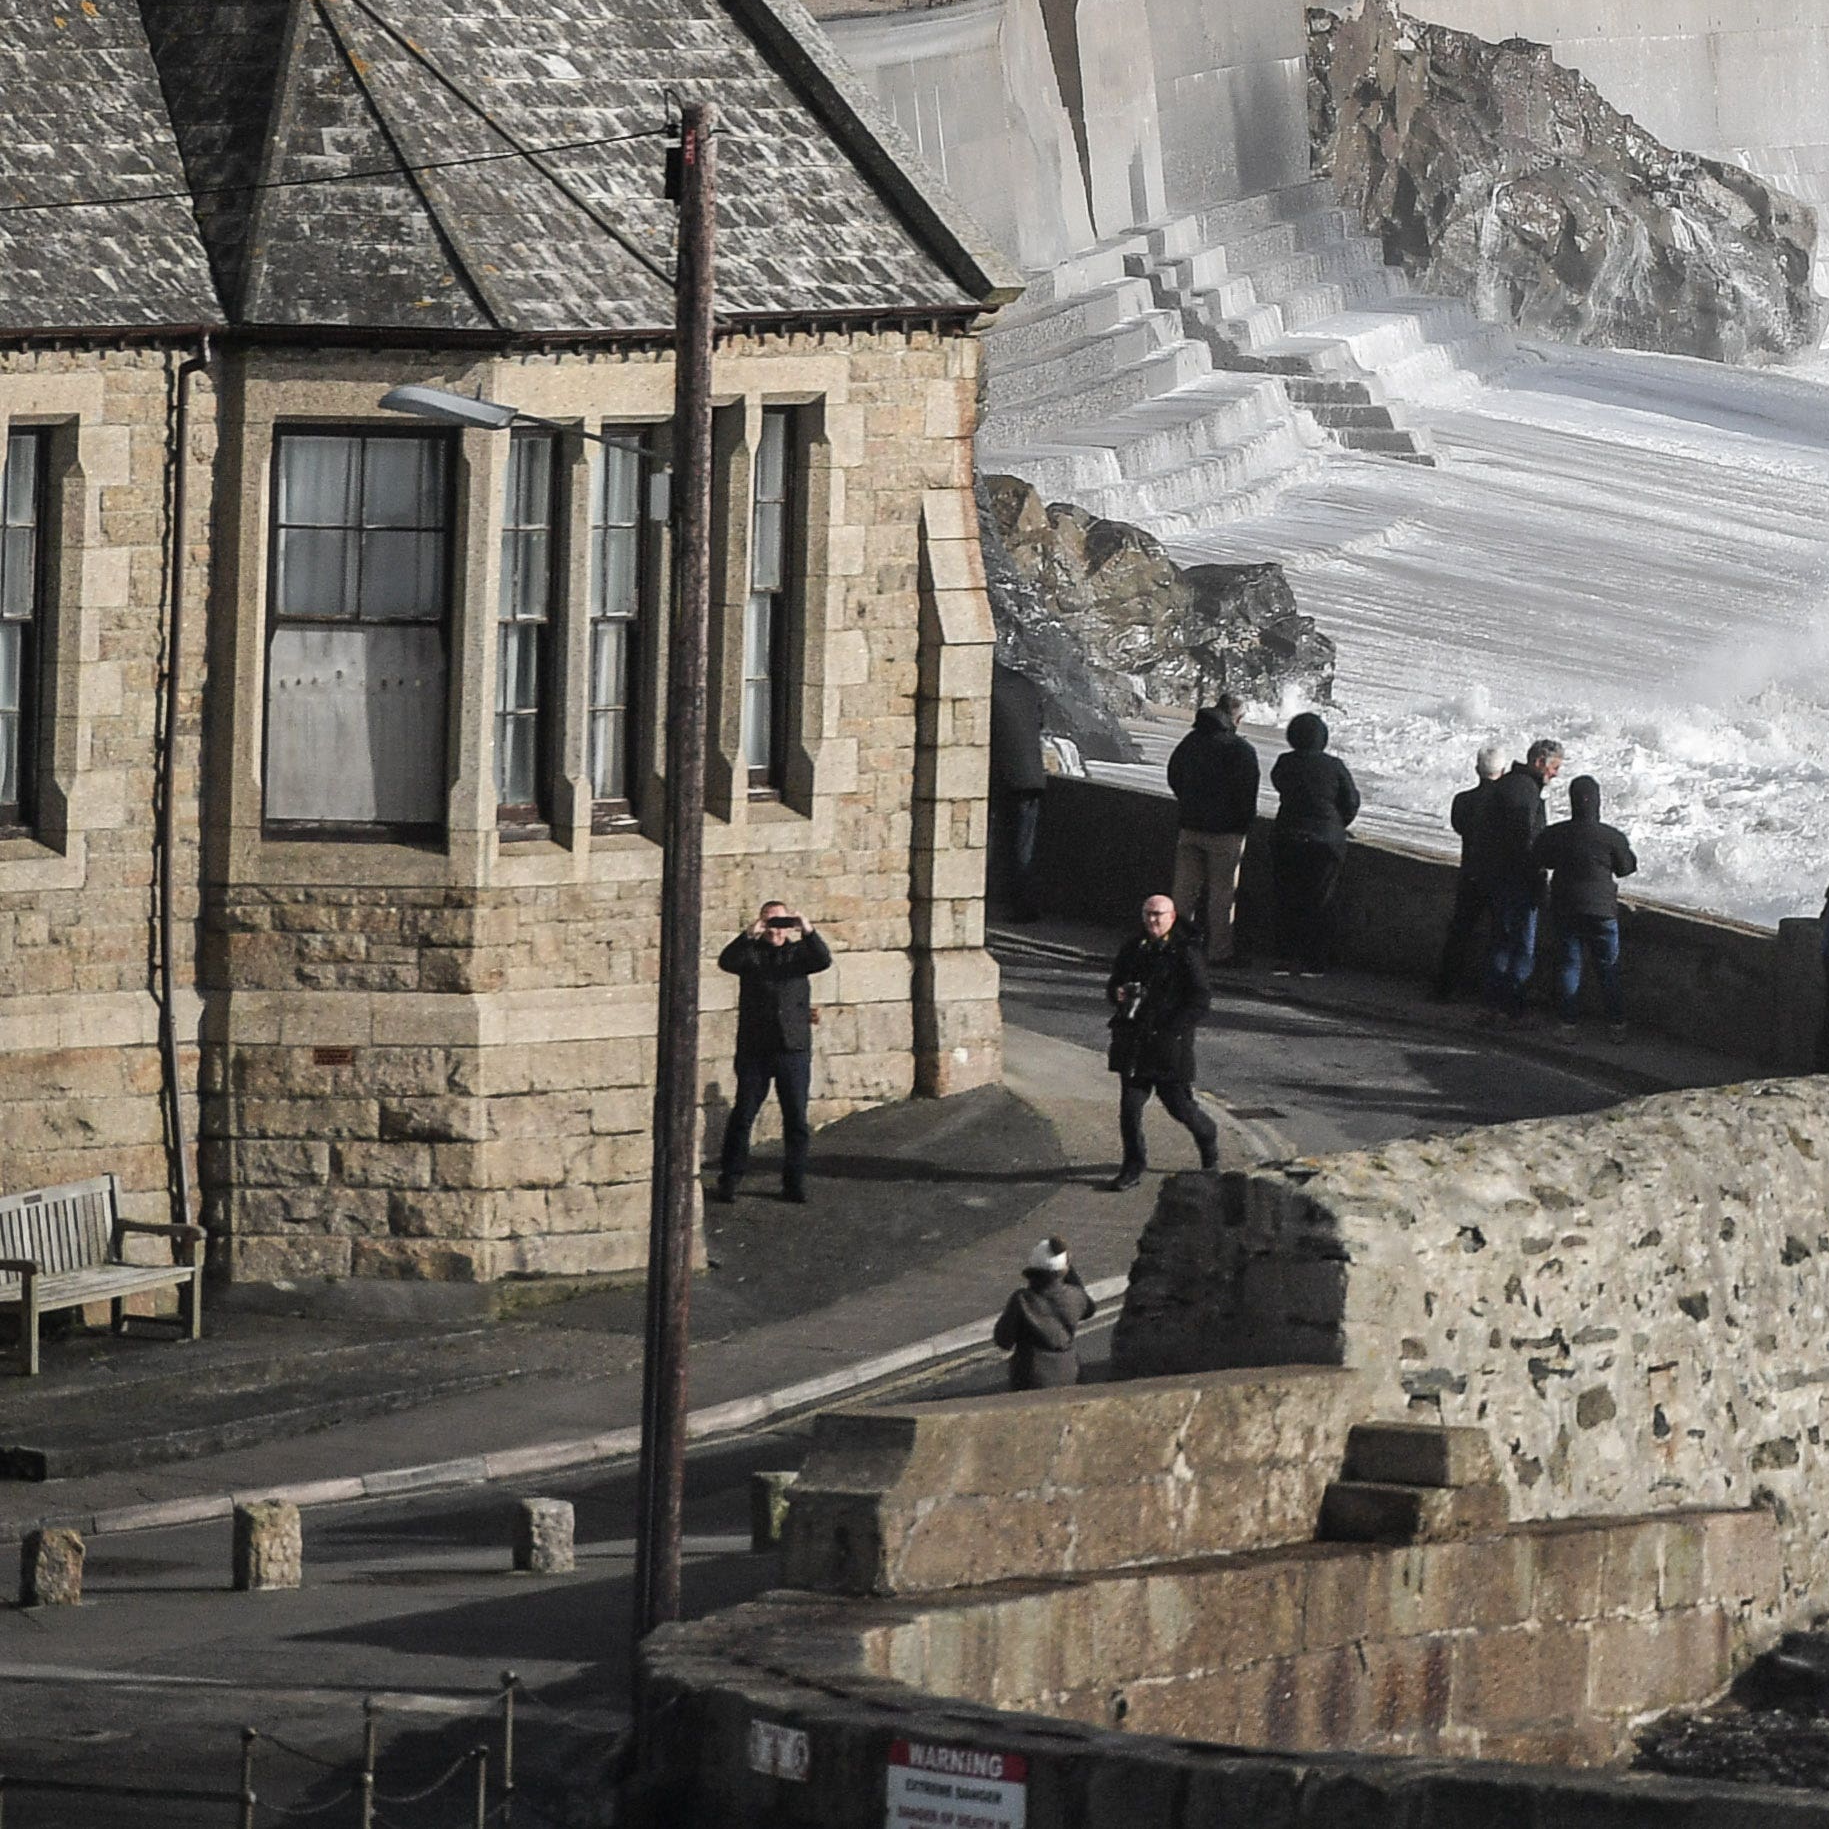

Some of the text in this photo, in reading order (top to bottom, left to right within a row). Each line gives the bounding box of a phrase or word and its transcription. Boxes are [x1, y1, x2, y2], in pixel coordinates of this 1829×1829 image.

[909, 1743, 1003, 1777] WARNING
[905, 1778, 1003, 1804] EXTREME DANGER
